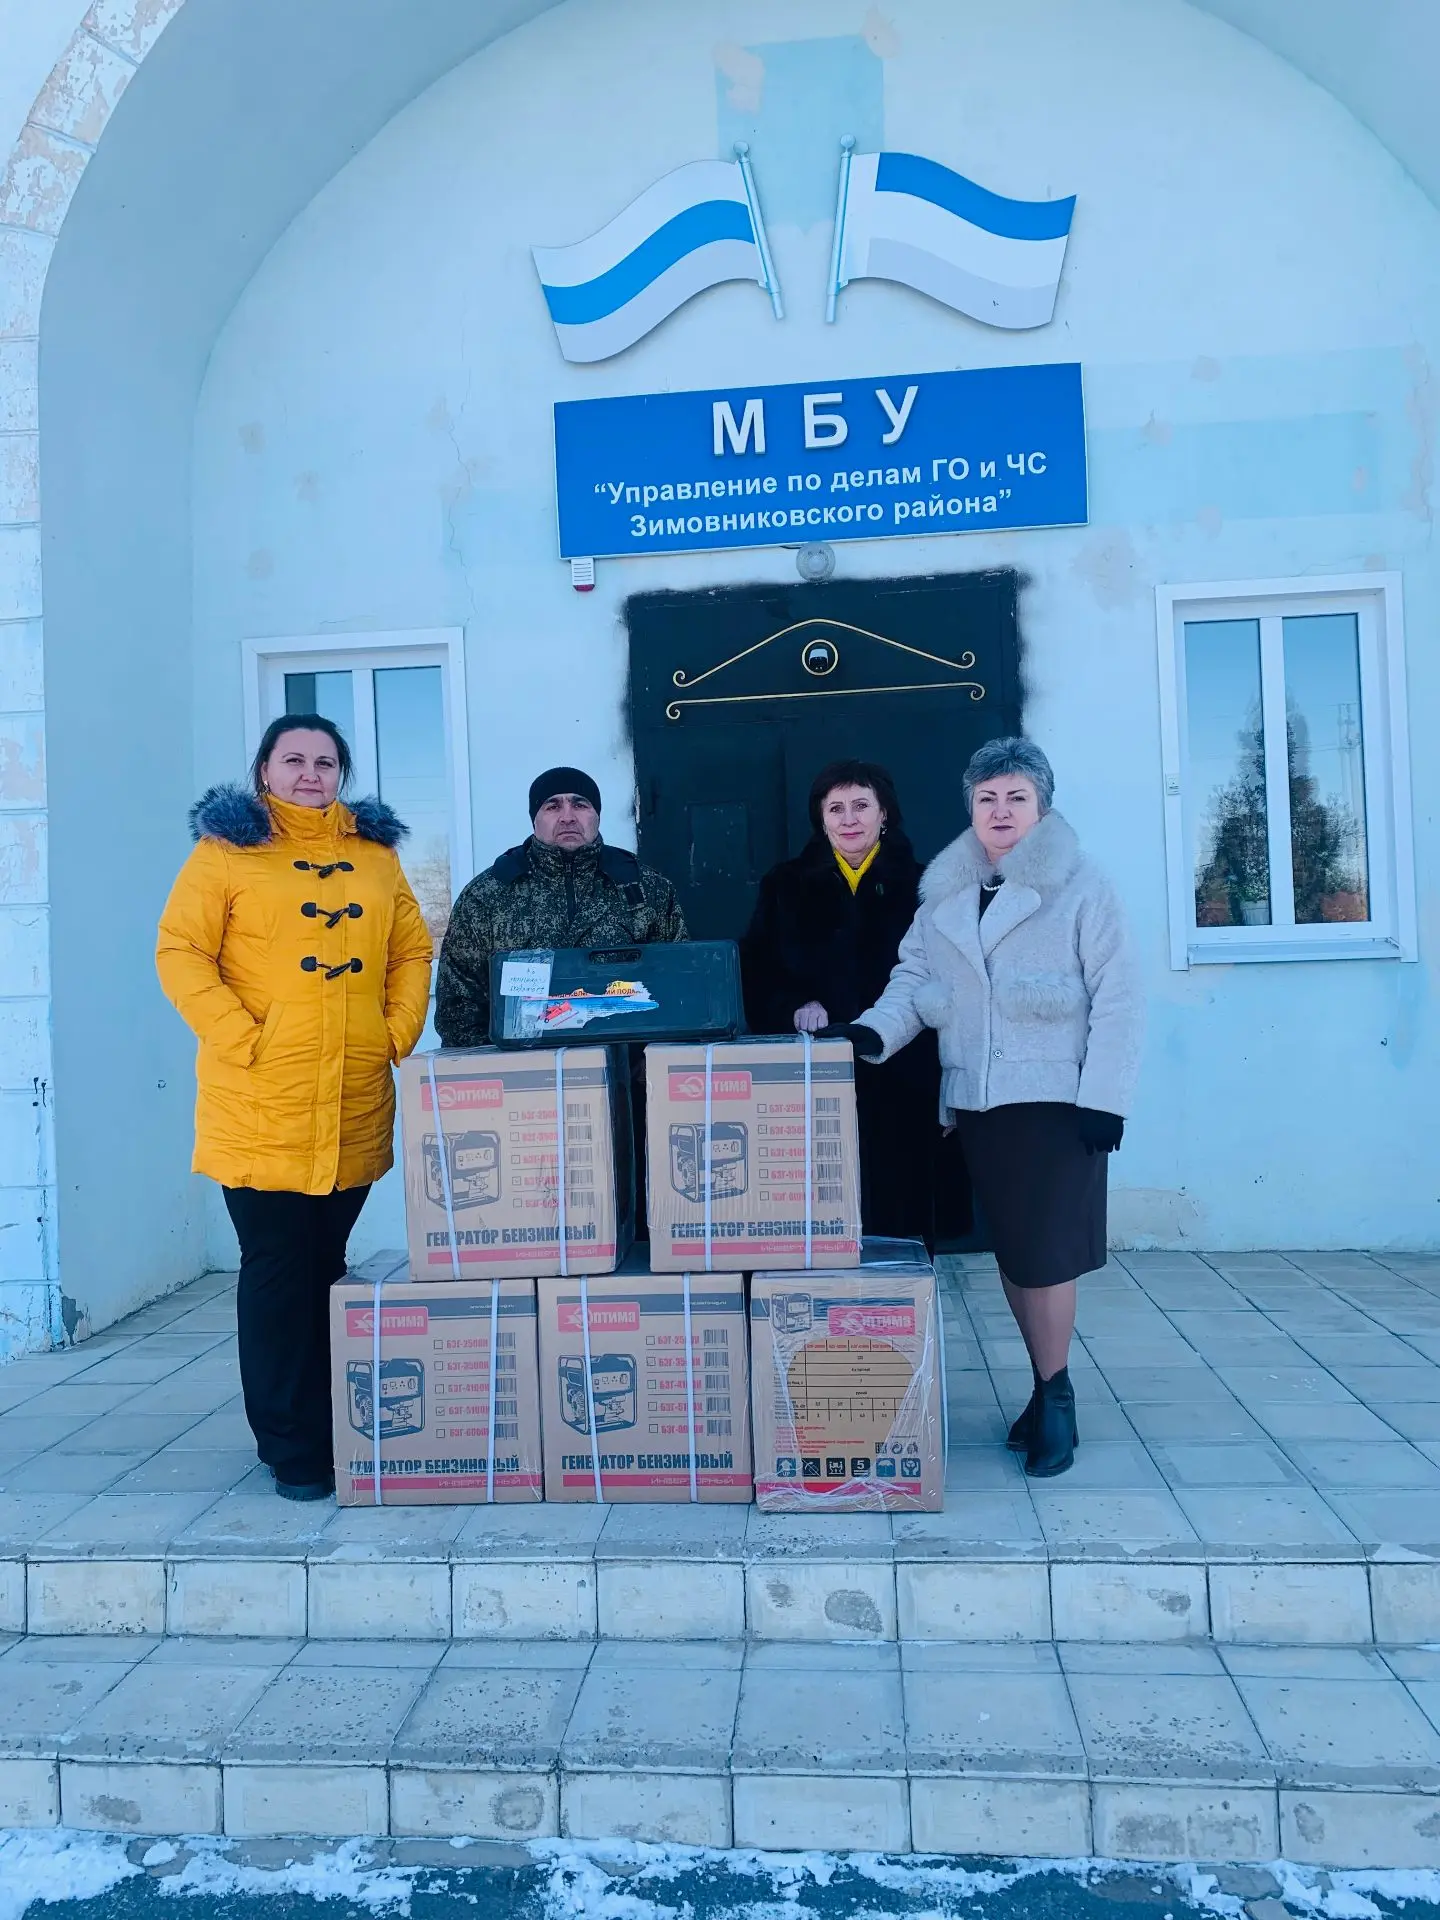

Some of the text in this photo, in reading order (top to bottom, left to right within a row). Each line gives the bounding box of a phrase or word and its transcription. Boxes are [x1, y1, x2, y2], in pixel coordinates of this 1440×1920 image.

[594, 451, 1048, 506] “Управление по делам ГО и ЧС
[630, 488, 1013, 537] Зимовниковского района”
[426, 1229, 499, 1247] ГЕНРАТОР
[671, 1222, 745, 1238] ГЕНЕАТОР
[424, 1454, 520, 1474] БЕНЗИНОЫЙ
[561, 1454, 635, 1470] ГЕНЕАТОР
[857, 1460, 865, 1470] 5
